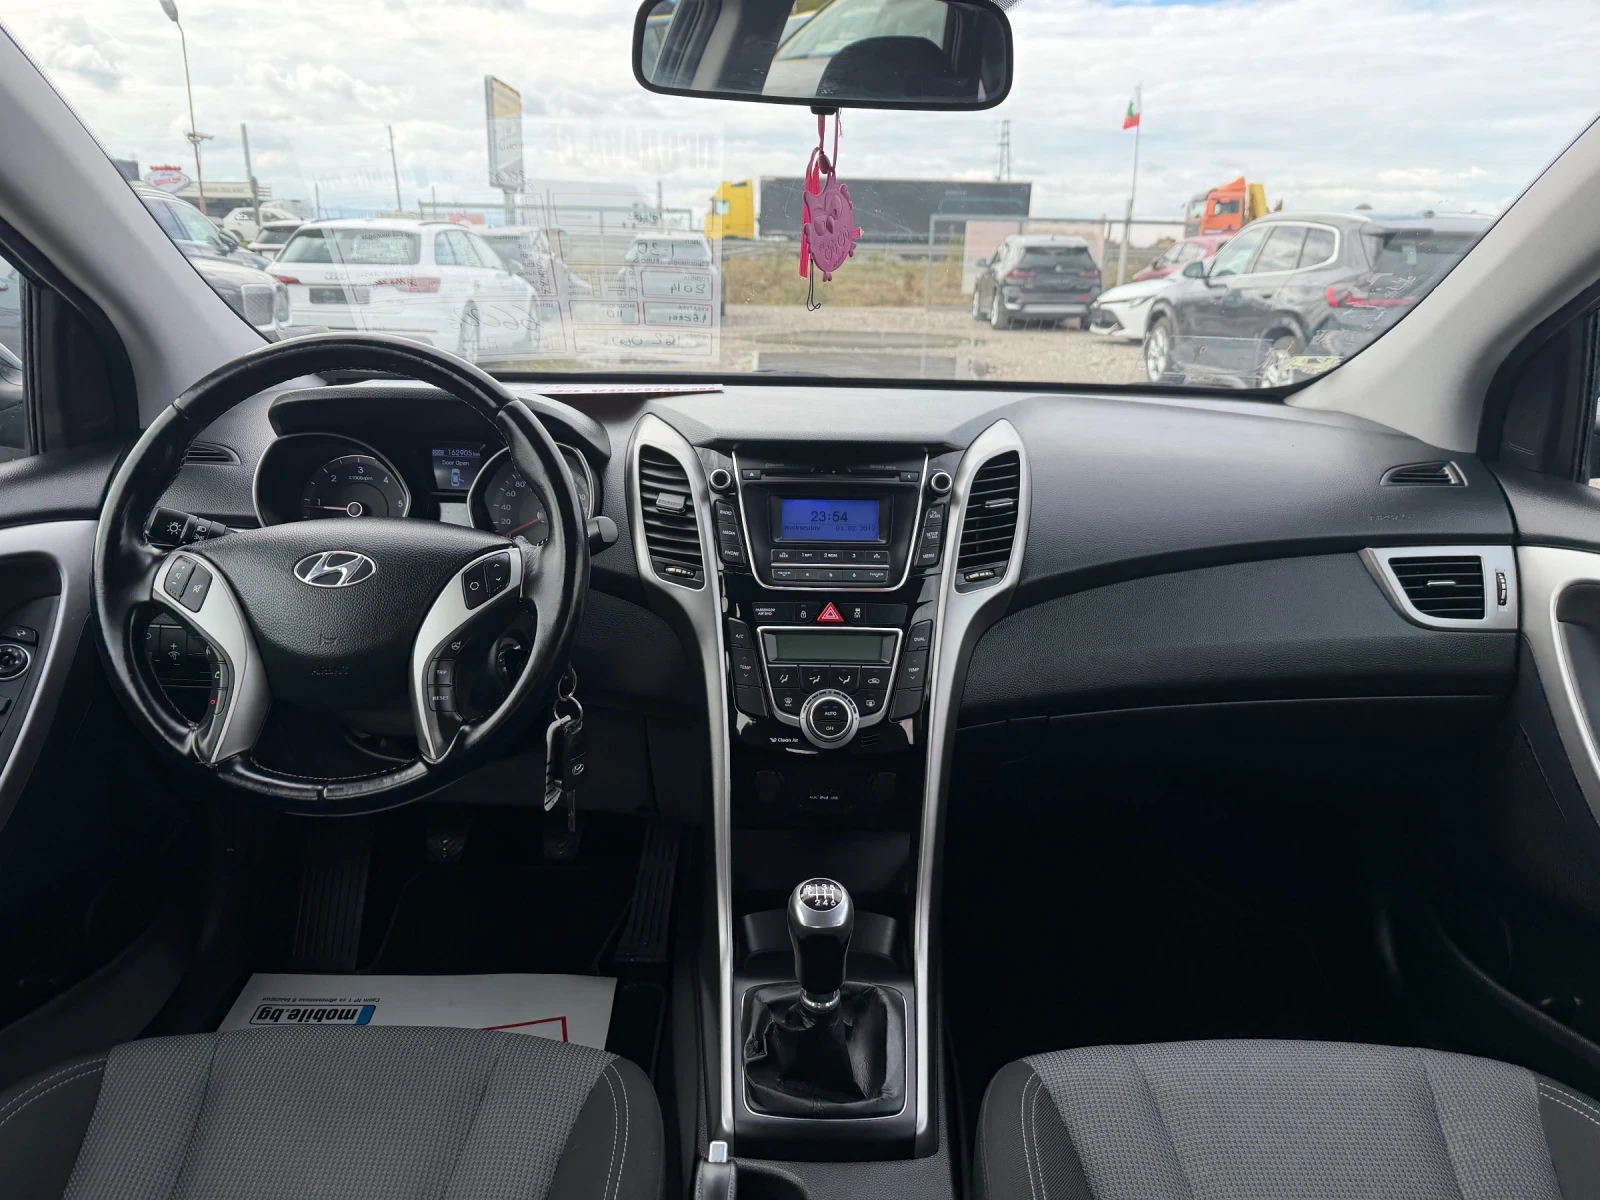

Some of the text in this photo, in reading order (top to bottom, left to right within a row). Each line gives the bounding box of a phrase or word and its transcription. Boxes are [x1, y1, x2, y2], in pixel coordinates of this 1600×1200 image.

[330, 474, 337, 483] 2
[383, 476, 389, 484] 4
[398, 500, 403, 508] 5
[810, 510, 848, 522] 23:54
[256, 1006, 358, 1023] mobile.bg
